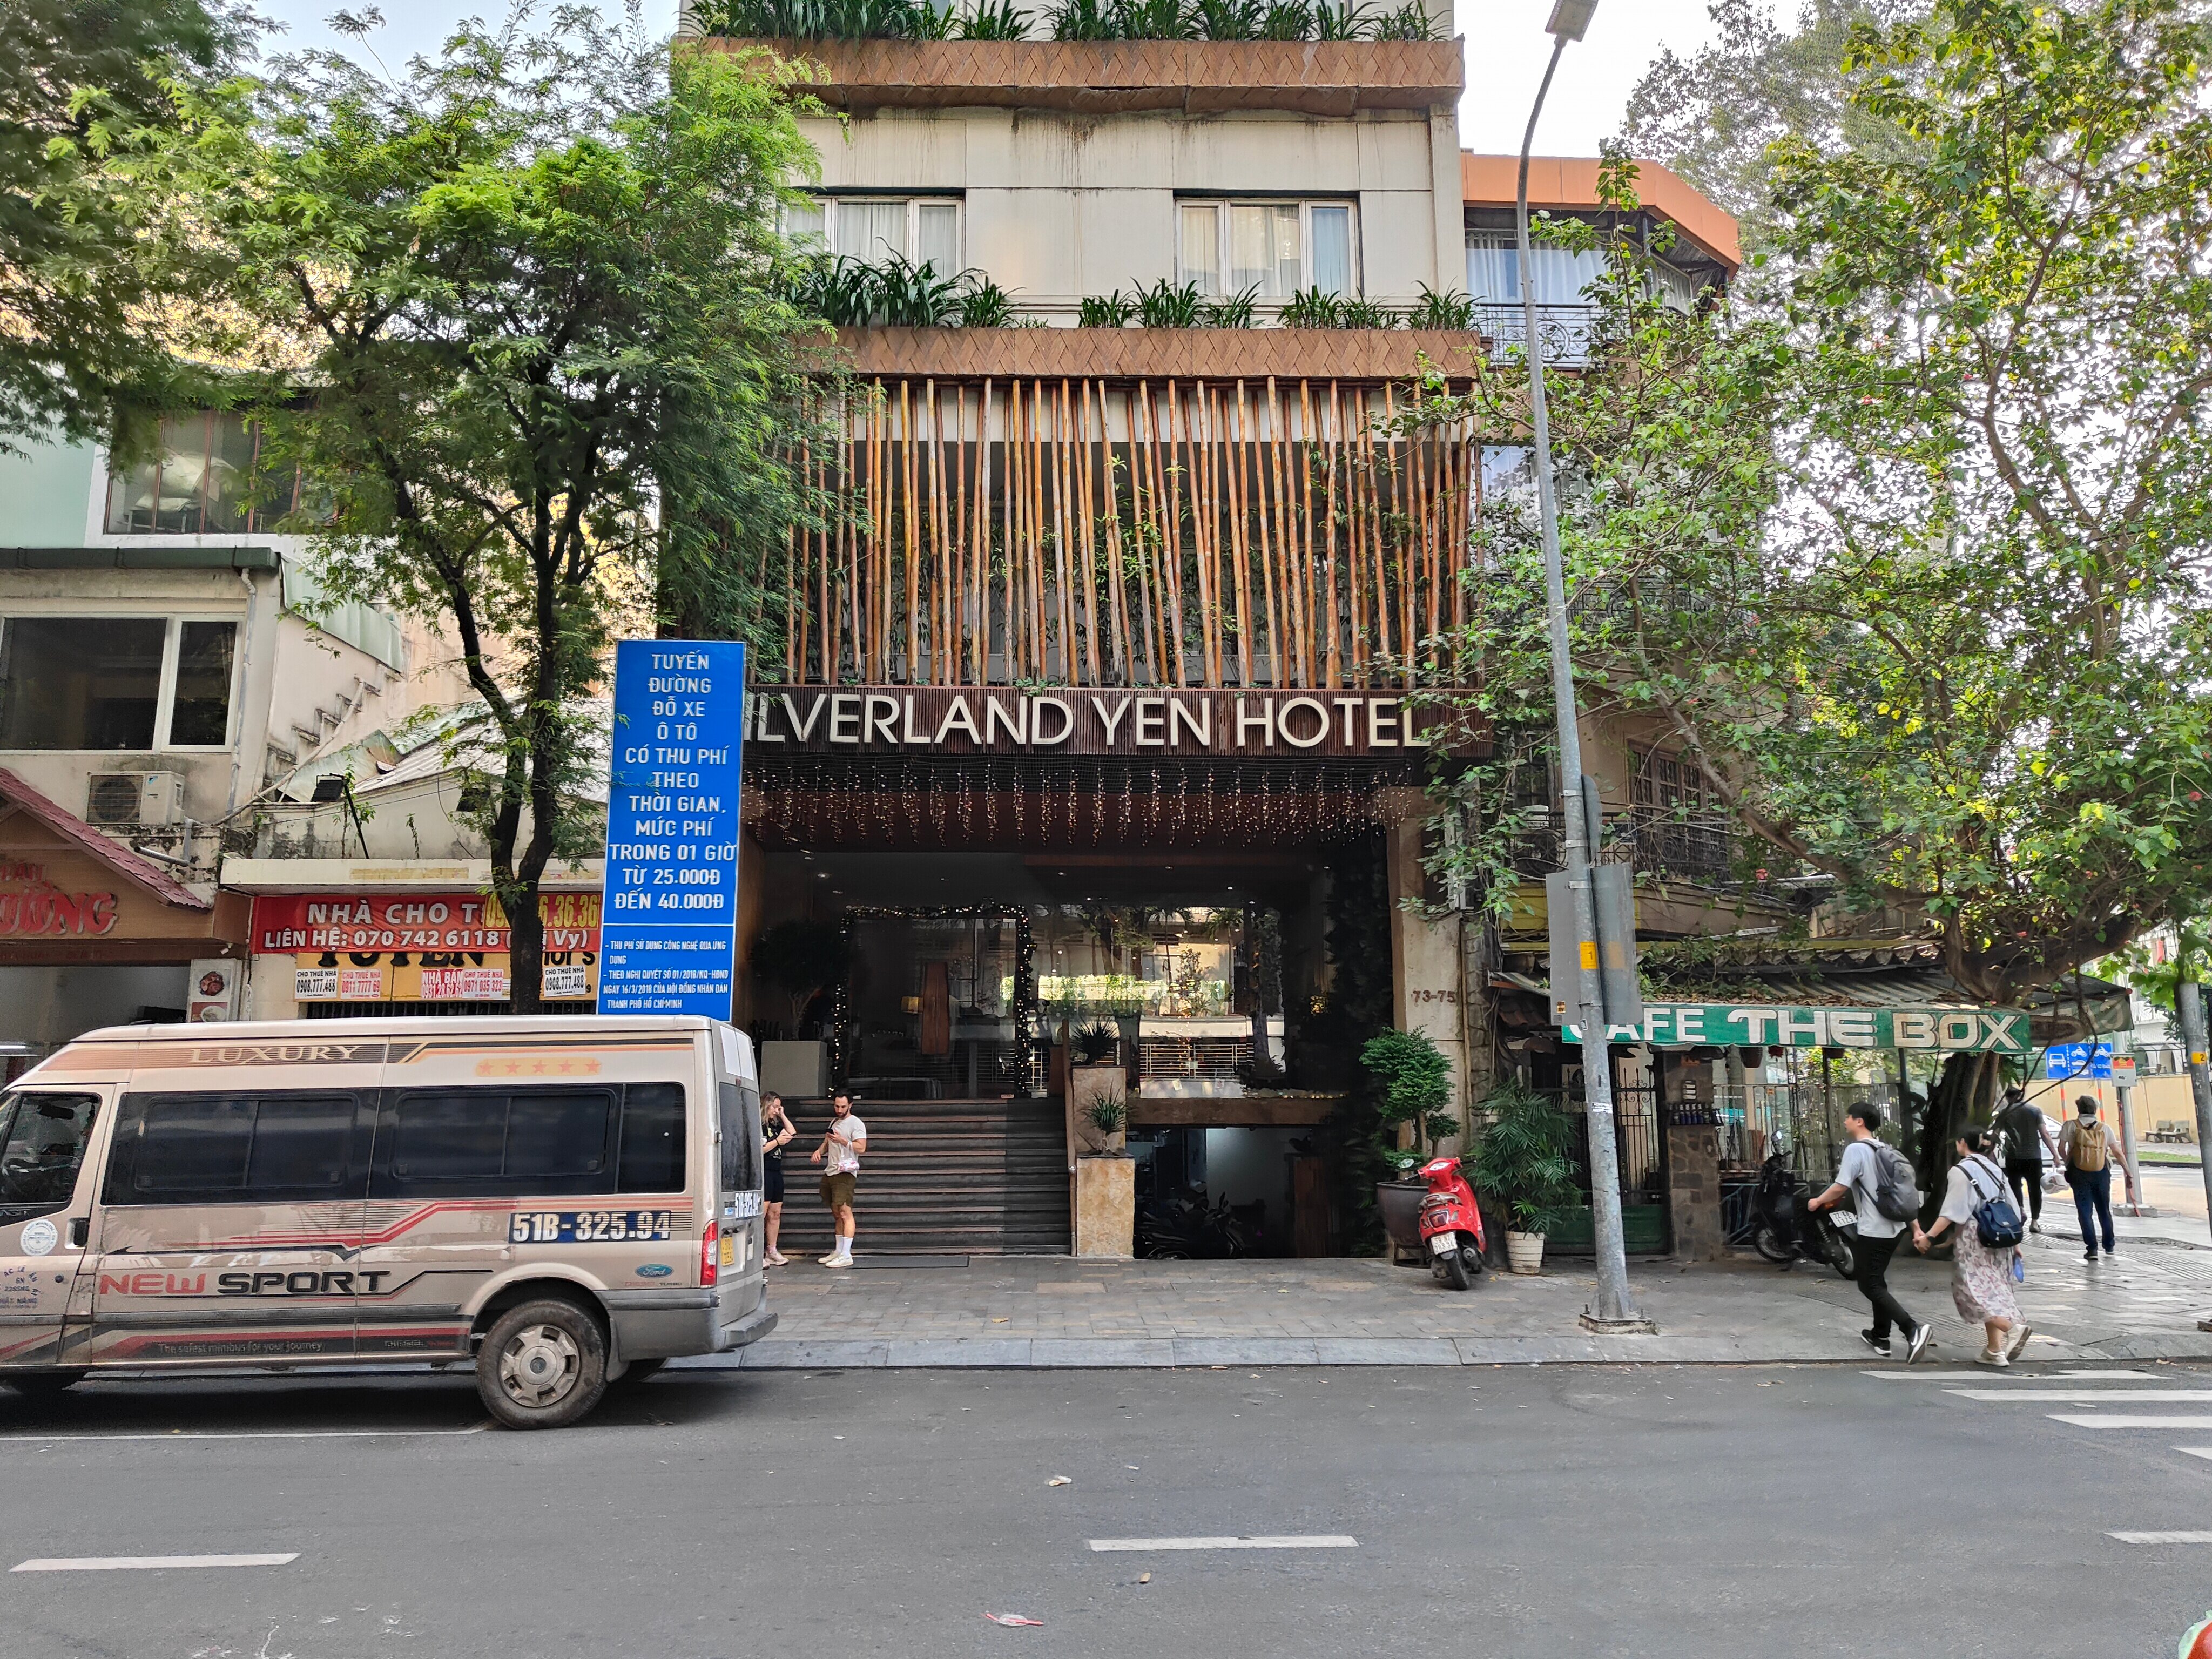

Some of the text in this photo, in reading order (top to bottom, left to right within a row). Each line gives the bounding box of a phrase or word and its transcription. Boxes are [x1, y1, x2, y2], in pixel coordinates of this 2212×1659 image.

[651, 650, 710, 670] TUYẾN
[648, 673, 712, 693] ĐƯỜNG
[652, 696, 706, 717] ĐỖ XE
[657, 721, 698, 740] Ô TÔ
[743, 693, 1431, 747] ILVERLAND YEN HOTEL
[625, 744, 730, 765] CÓ THU PHÍ
[652, 772, 700, 788] THEO
[629, 792, 726, 813] THỜI GIAN,
[635, 815, 716, 837] MỨC PHÍ
[609, 841, 737, 861] TRONG 01 GIỜ
[622, 864, 721, 885] TỪ 25.000Đ
[614, 887, 724, 909] ĐẾN 40.000Đ
[308, 900, 373, 923] NHÀ
[385, 903, 448, 923] CHO
[265, 928, 306, 947] LIÊN
[312, 927, 348, 950] HỆ:
[354, 930, 394, 946] 070
[401, 930, 439, 946] 742
[446, 930, 499, 946] 6118
[553, 930, 588, 949] Vy)
[610, 941, 622, 950] THU
[664, 940, 680, 950] CÔNG
[699, 941, 712, 950] QUA
[422, 969, 442, 984] NHÀ
[609, 970, 624, 979] THEO
[603, 983, 619, 994] NGÀY
[1413, 990, 1455, 1003] 73-75
[1728, 1009, 1877, 1047] THE
[1893, 1013, 2024, 1049] BOX
[190, 1046, 362, 1065] LUXURY
[513, 1211, 670, 1242] 51B-325.94
[99, 1271, 391, 1296] NEW SPORT
